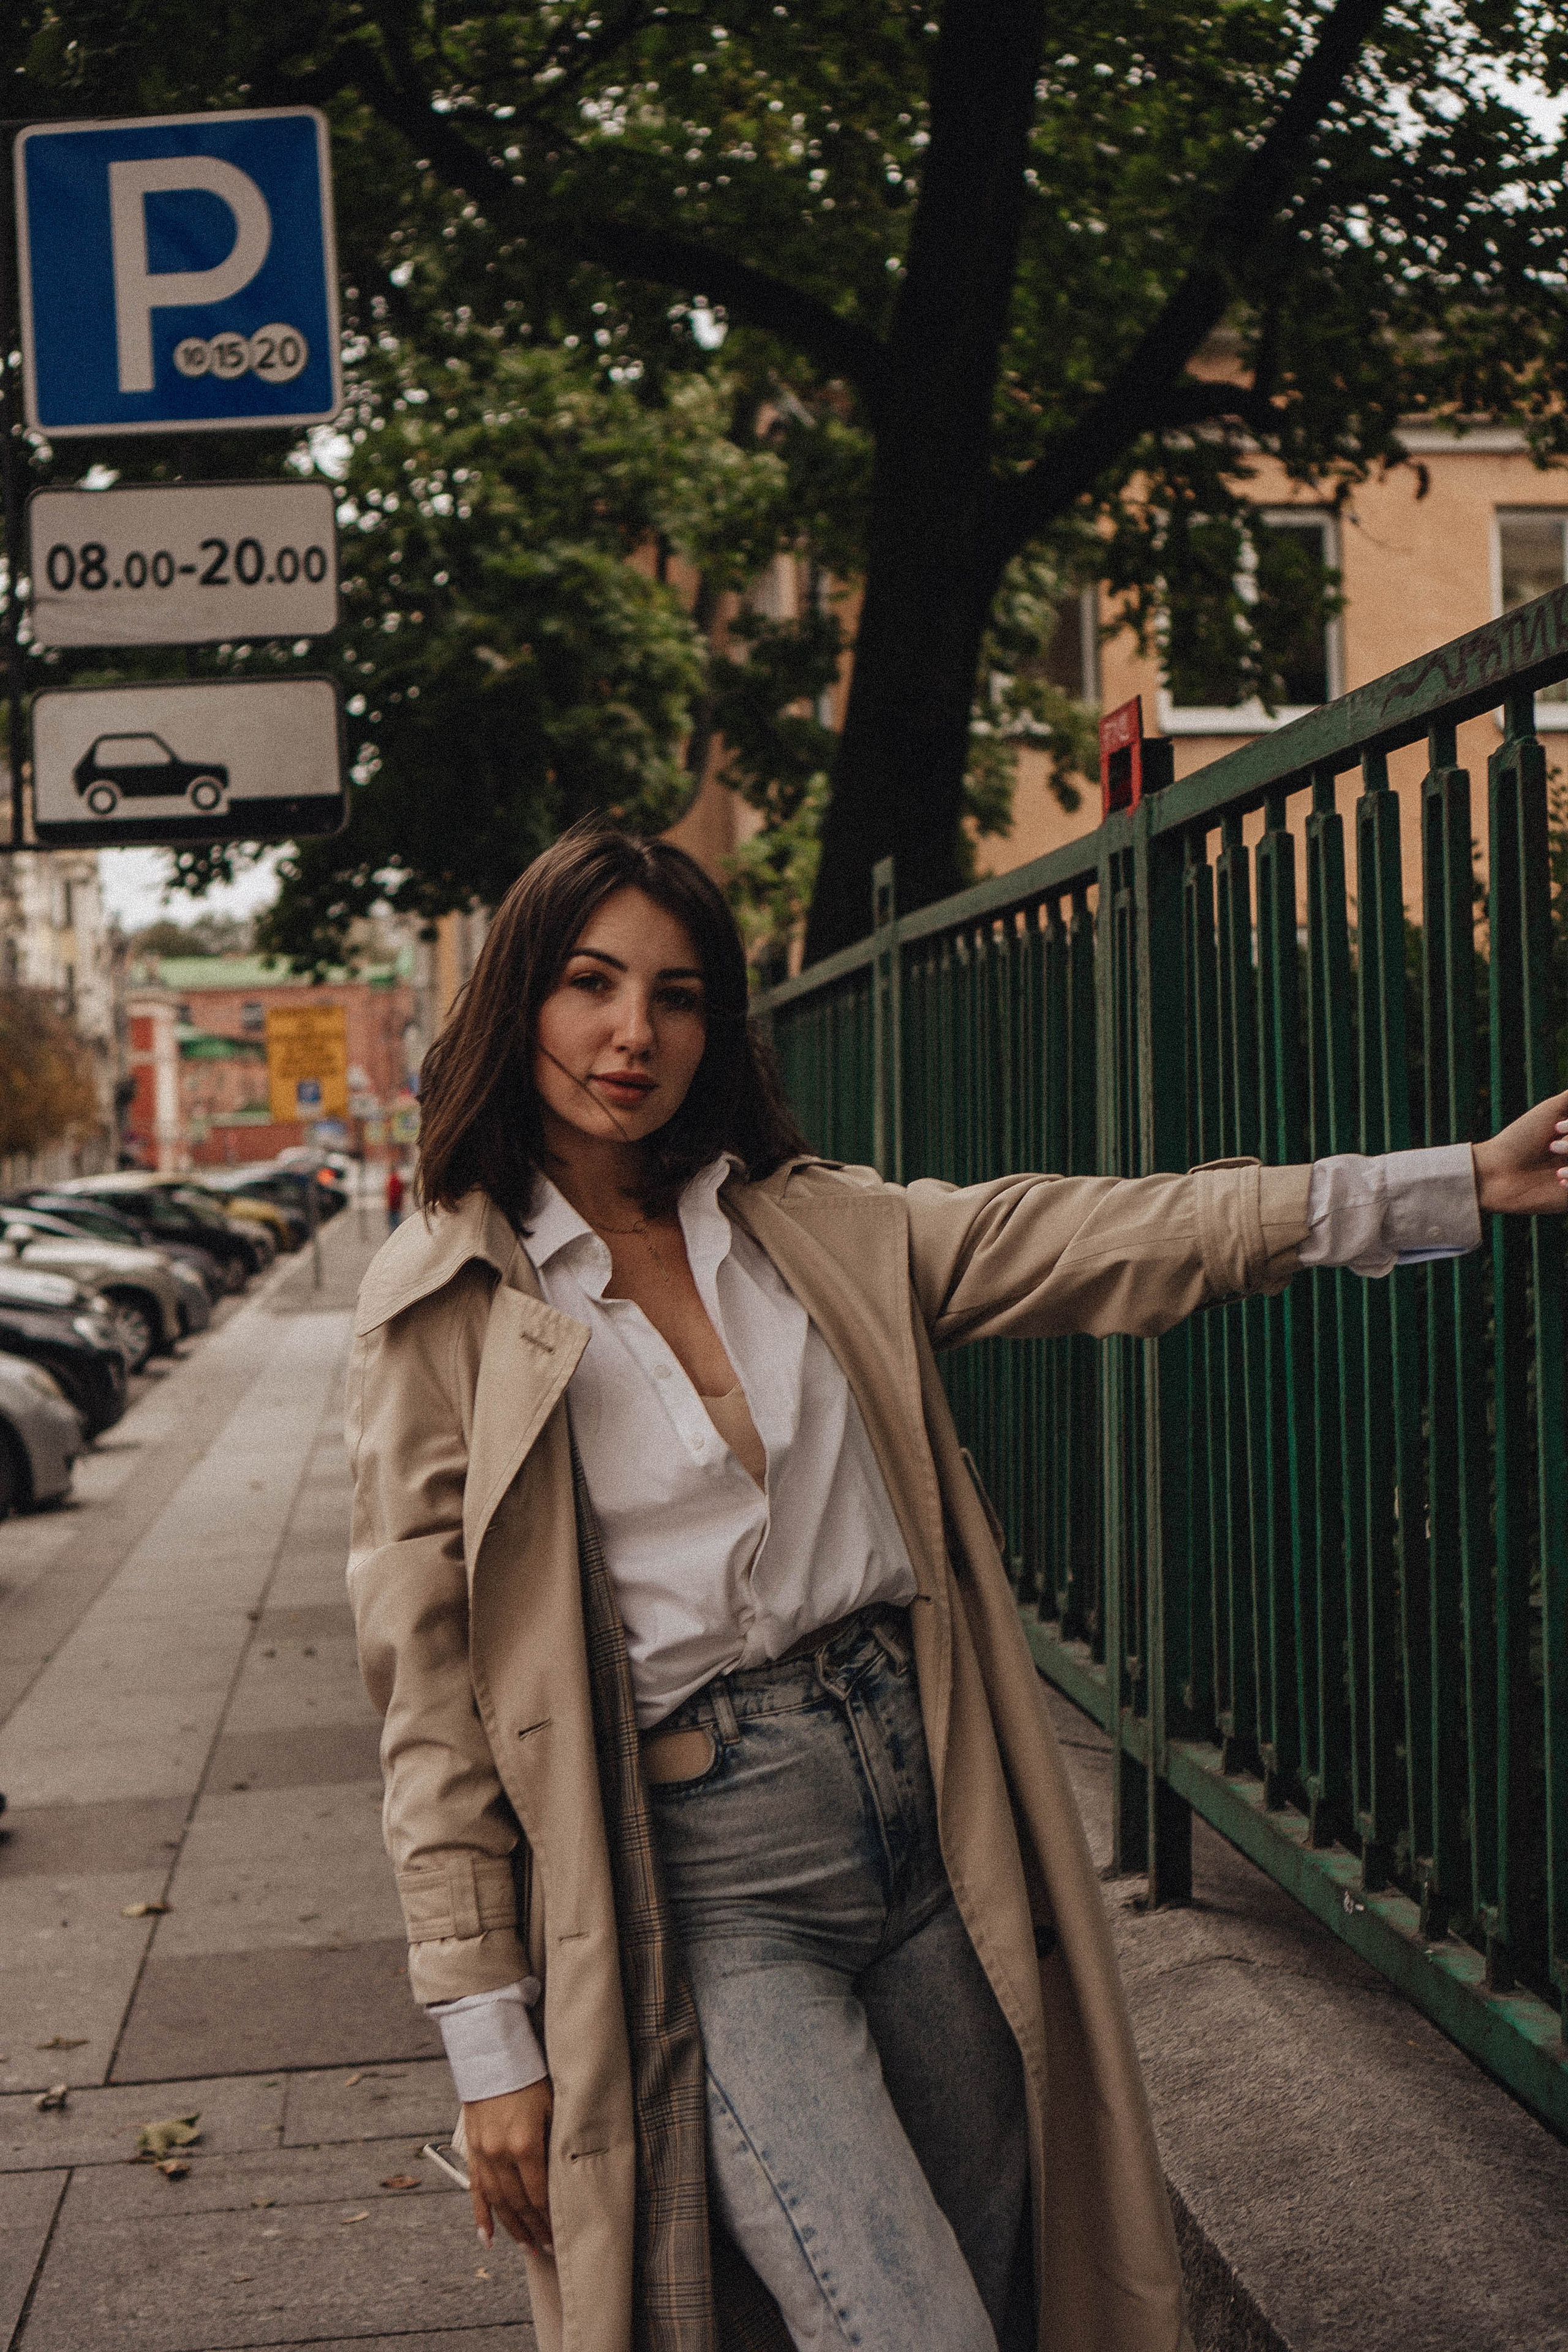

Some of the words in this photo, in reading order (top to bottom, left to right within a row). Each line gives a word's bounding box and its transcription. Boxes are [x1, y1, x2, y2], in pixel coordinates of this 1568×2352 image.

[108, 155, 271, 393] P
[183, 347, 206, 366] 10
[214, 342, 244, 368] 15
[256, 337, 300, 369] 20
[47, 537, 328, 590] 08.00-20.00
